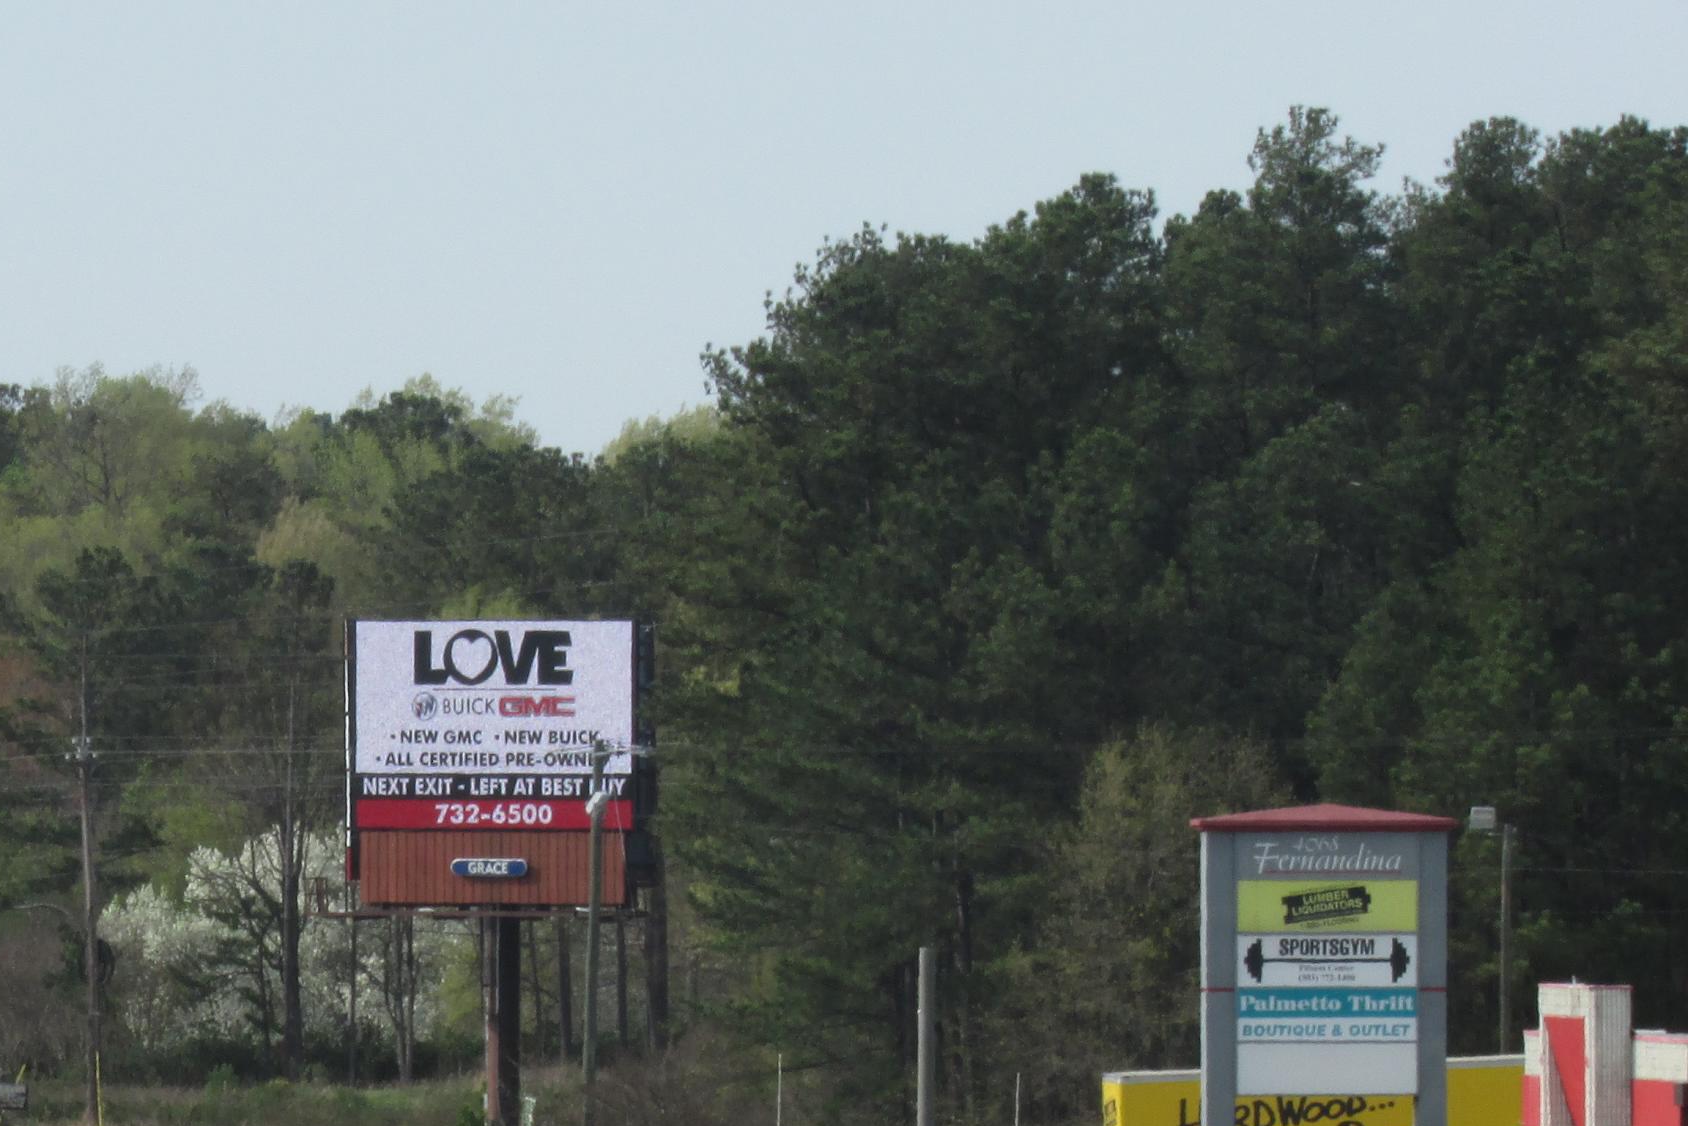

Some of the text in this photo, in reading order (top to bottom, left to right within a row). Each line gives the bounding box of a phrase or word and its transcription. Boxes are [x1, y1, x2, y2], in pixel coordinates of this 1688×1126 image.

[414, 629, 575, 685] LOVE
[443, 696, 576, 717] BUICK GMC
[400, 730, 600, 745] NEW GMC NEW BUICK
[385, 752, 594, 767] ALL CERTIFIED PRE-OWN
[363, 778, 408, 796] NEXT
[415, 778, 453, 796] EXIT
[470, 778, 508, 796] LEFT
[513, 778, 536, 796] AT
[541, 778, 583, 796] BEST
[435, 804, 553, 824] 732-6500
[1253, 842, 1401, 875] Fernandina
[467, 862, 509, 875] GRACE
[1303, 890, 1349, 905] LUMBER
[1291, 898, 1363, 916] LIQUIDATORS
[1279, 938, 1375, 956] SPORTSGYM
[1240, 995, 1415, 1012] Palmetto Thrift
[1242, 1024, 1411, 1037] BOUTIQUE & OUTLET
